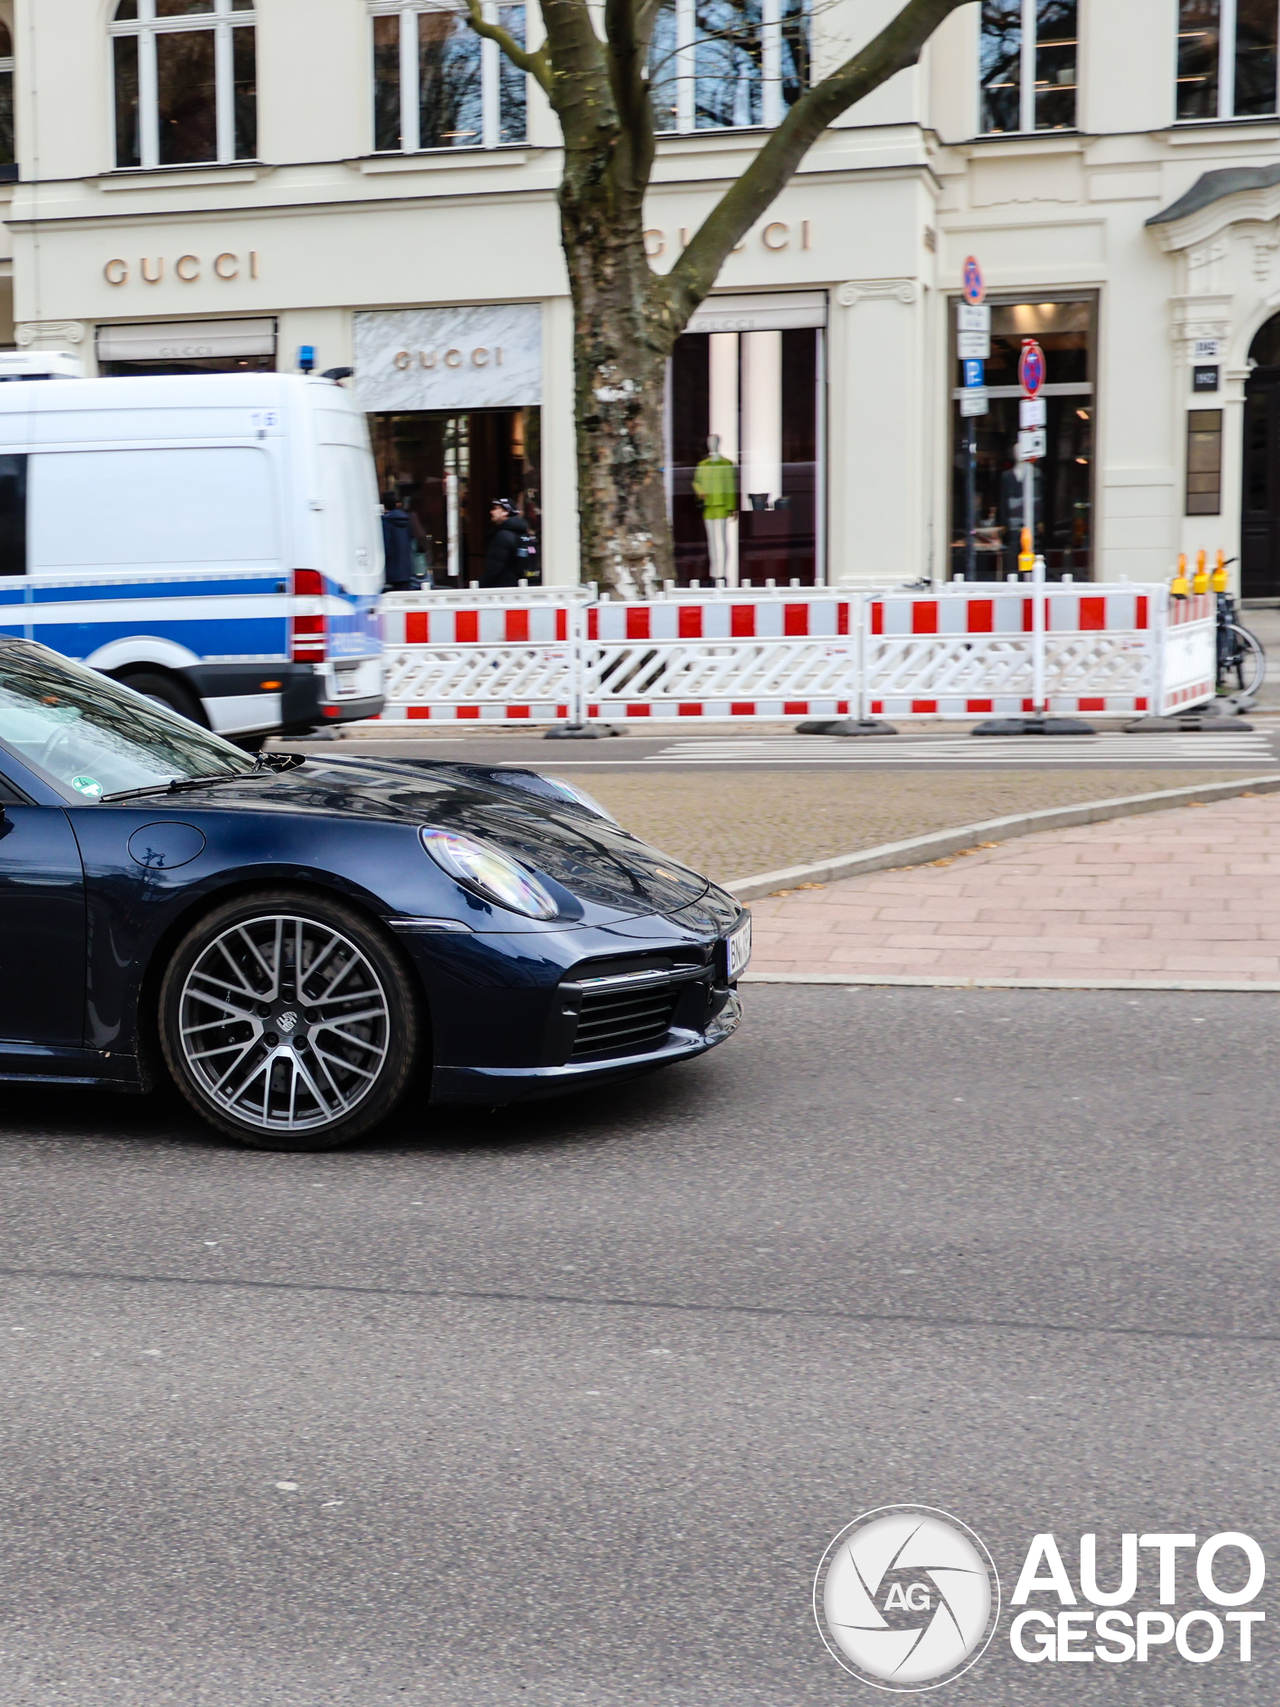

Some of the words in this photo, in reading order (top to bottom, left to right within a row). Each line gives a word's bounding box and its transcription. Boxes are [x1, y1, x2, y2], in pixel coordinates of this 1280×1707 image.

[643, 220, 810, 257] GCI
[104, 251, 258, 286] GUCCI
[394, 347, 503, 370] GUCCI
